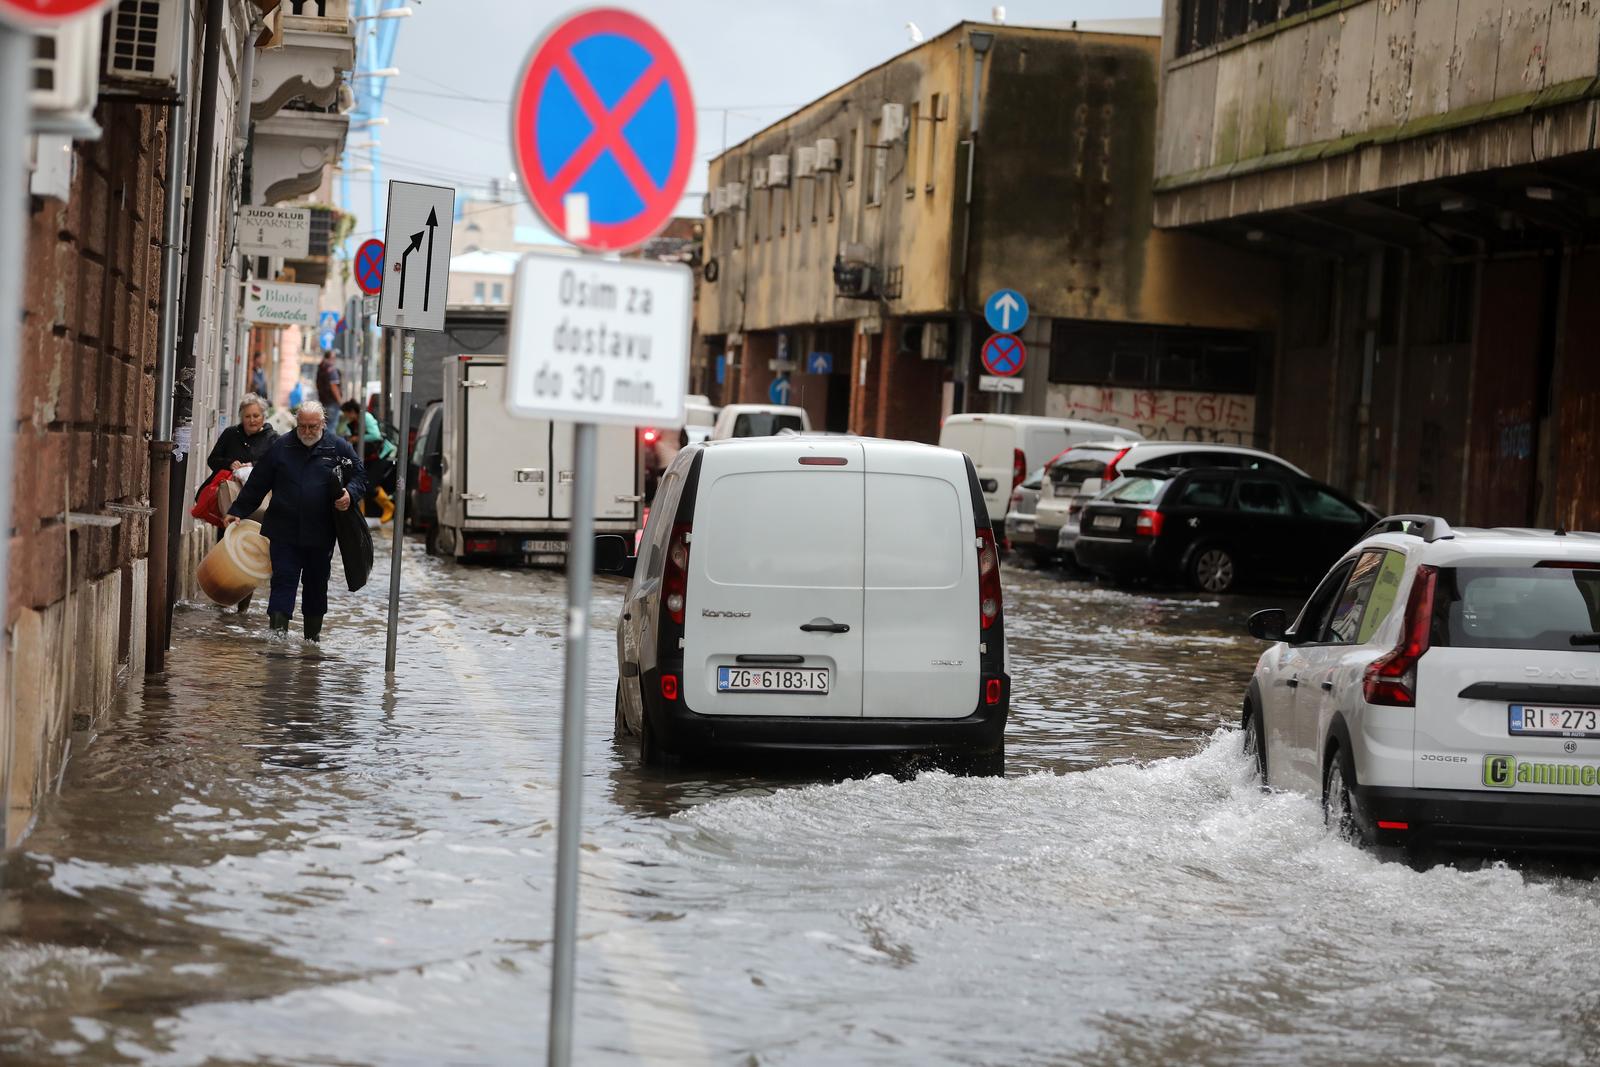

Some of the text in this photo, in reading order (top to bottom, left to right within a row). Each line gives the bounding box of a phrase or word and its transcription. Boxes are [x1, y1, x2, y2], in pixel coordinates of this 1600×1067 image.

[247, 210, 304, 220] JUDO KLUB
[558, 268, 653, 315] Osim za
[256, 304, 308, 321] Vinoteka
[552, 317, 653, 361] dostavu
[533, 362, 662, 408] do 30 min.
[731, 670, 751, 688] ZG
[1512, 708, 1596, 730] HR RI 273
[1420, 754, 1468, 763] JOGGER
[1491, 757, 1600, 786] Camme
